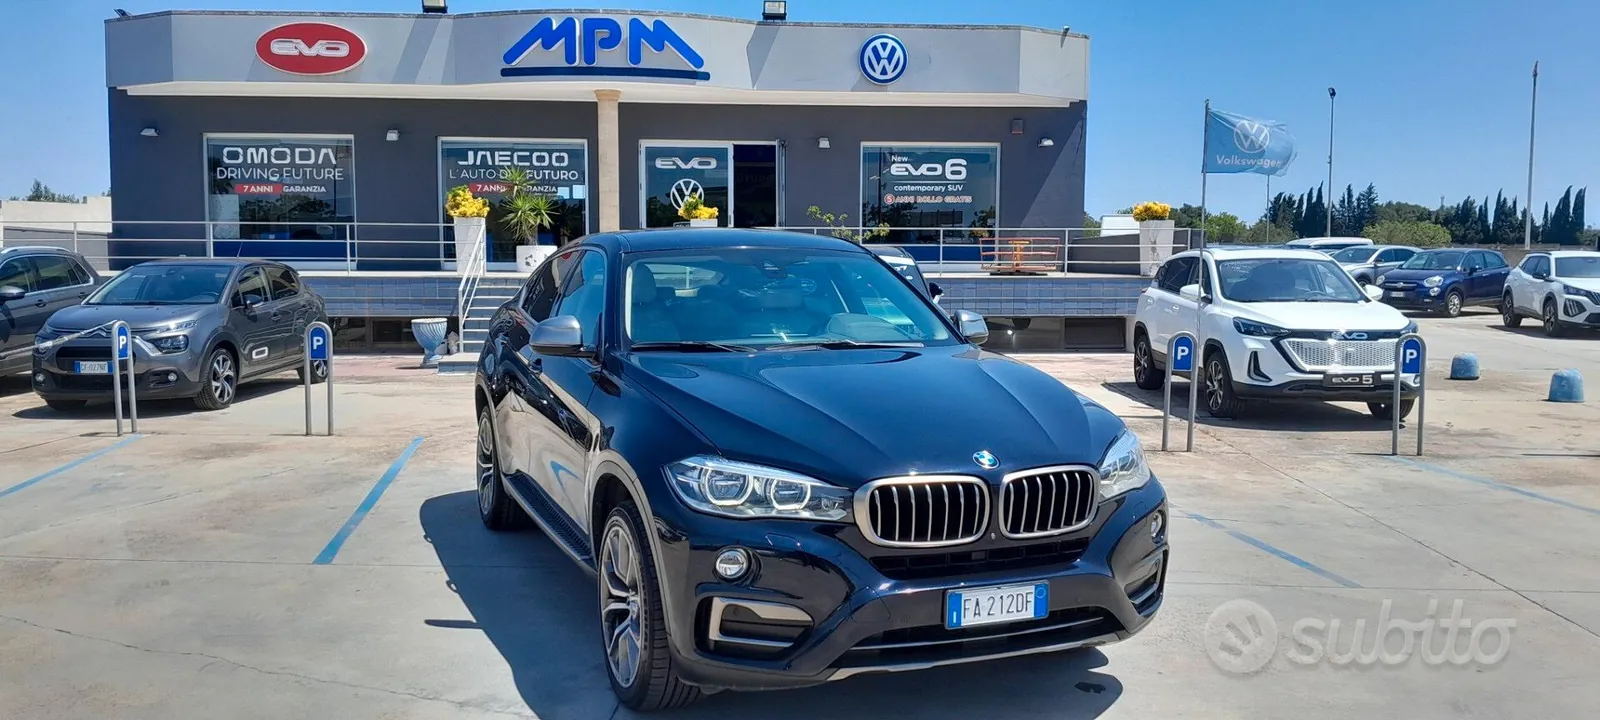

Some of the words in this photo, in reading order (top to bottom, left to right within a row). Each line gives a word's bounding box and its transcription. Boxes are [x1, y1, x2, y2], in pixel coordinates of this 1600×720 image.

[503, 17, 704, 69] MPM
[223, 147, 337, 164] OMODA
[457, 150, 569, 167] JAECOO
[1216, 154, 1282, 168] Volkswagen
[655, 157, 717, 169] EVO
[216, 167, 280, 180] DRIVING
[283, 168, 344, 180] FUTURE
[526, 170, 579, 180] FUTURO
[243, 185, 248, 193] 7
[250, 185, 273, 193] ANNI
[283, 185, 326, 193] GARANZIA
[476, 184, 482, 192] 7
[894, 185, 946, 193] contemporary
[947, 184, 964, 192] SUV
[119, 335, 127, 349] P
[313, 336, 323, 350] P
[1177, 346, 1189, 360] P
[1405, 349, 1417, 364] P
[1362, 374, 1373, 384] 5
[963, 598, 981, 619] FA
[987, 591, 1034, 617] 212DF
